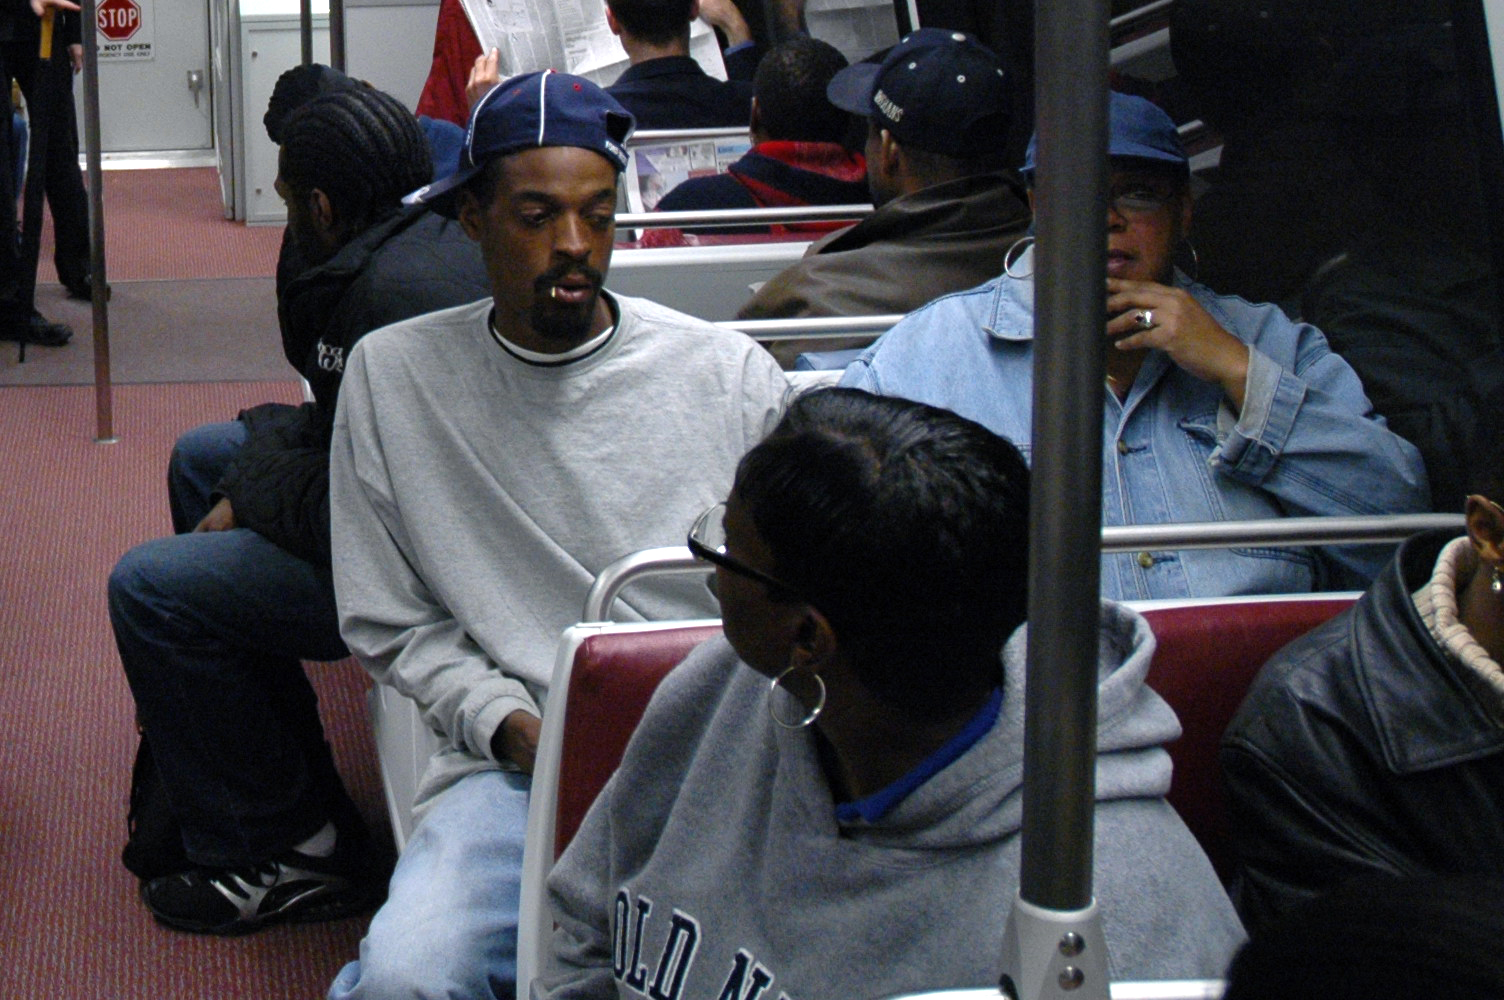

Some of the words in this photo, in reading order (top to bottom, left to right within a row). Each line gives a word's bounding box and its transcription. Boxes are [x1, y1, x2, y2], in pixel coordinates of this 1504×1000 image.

[98, 8, 137, 28] STOP
[126, 43, 151, 51] OPEN
[612, 886, 702, 1000] OLD
